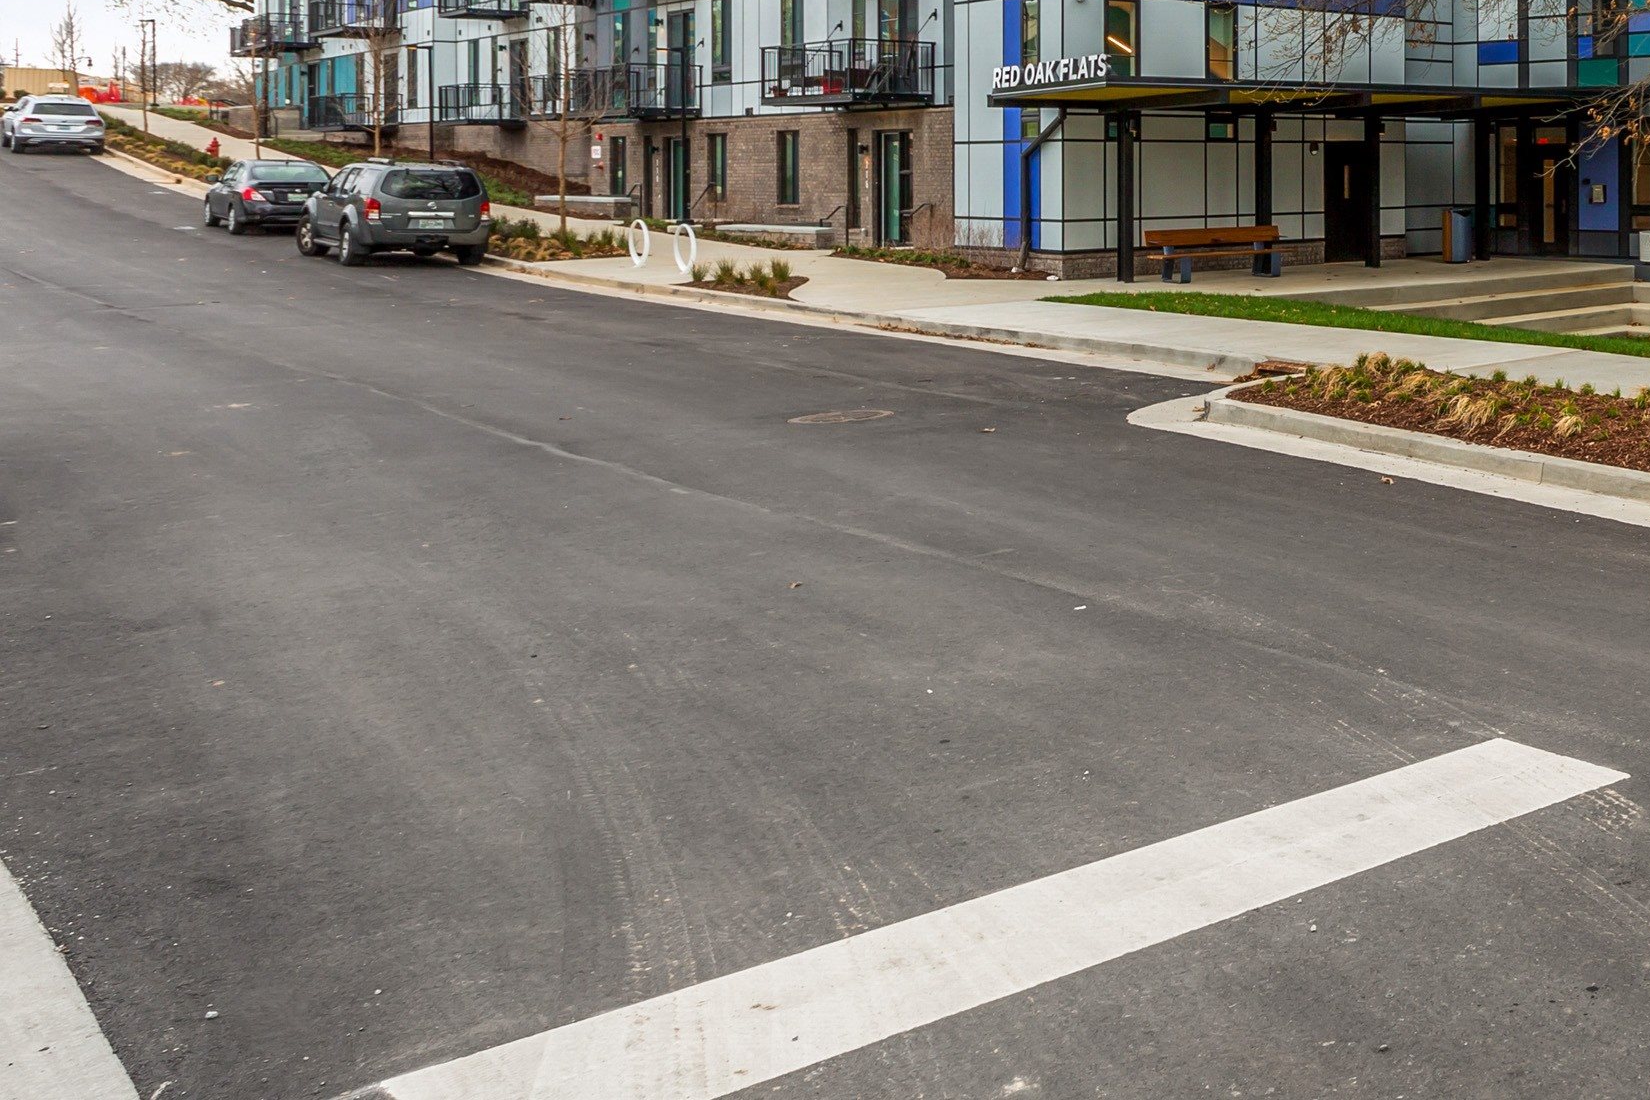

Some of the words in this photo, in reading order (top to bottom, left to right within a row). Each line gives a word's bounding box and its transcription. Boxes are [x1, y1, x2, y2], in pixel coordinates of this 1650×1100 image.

[992, 65, 1021, 89] RED
[1024, 60, 1056, 86] OAK
[1059, 53, 1107, 82] FLATS
